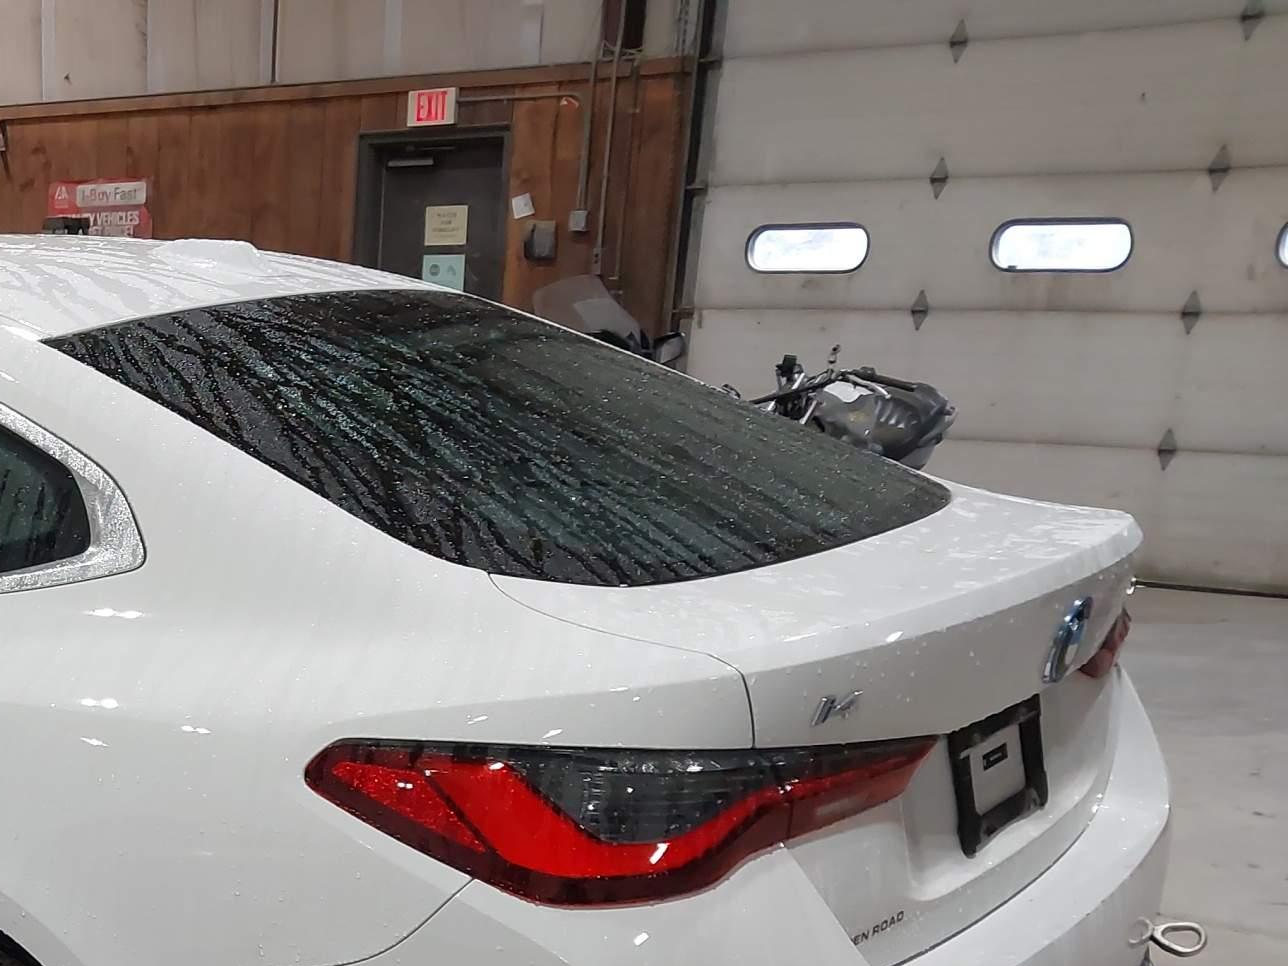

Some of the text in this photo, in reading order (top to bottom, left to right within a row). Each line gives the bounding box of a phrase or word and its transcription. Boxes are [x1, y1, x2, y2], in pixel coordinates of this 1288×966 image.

[416, 91, 447, 121] EXIT
[113, 187, 137, 201] Fast
[96, 211, 140, 225] VEHICLES
[872, 910, 905, 937] ROAD
